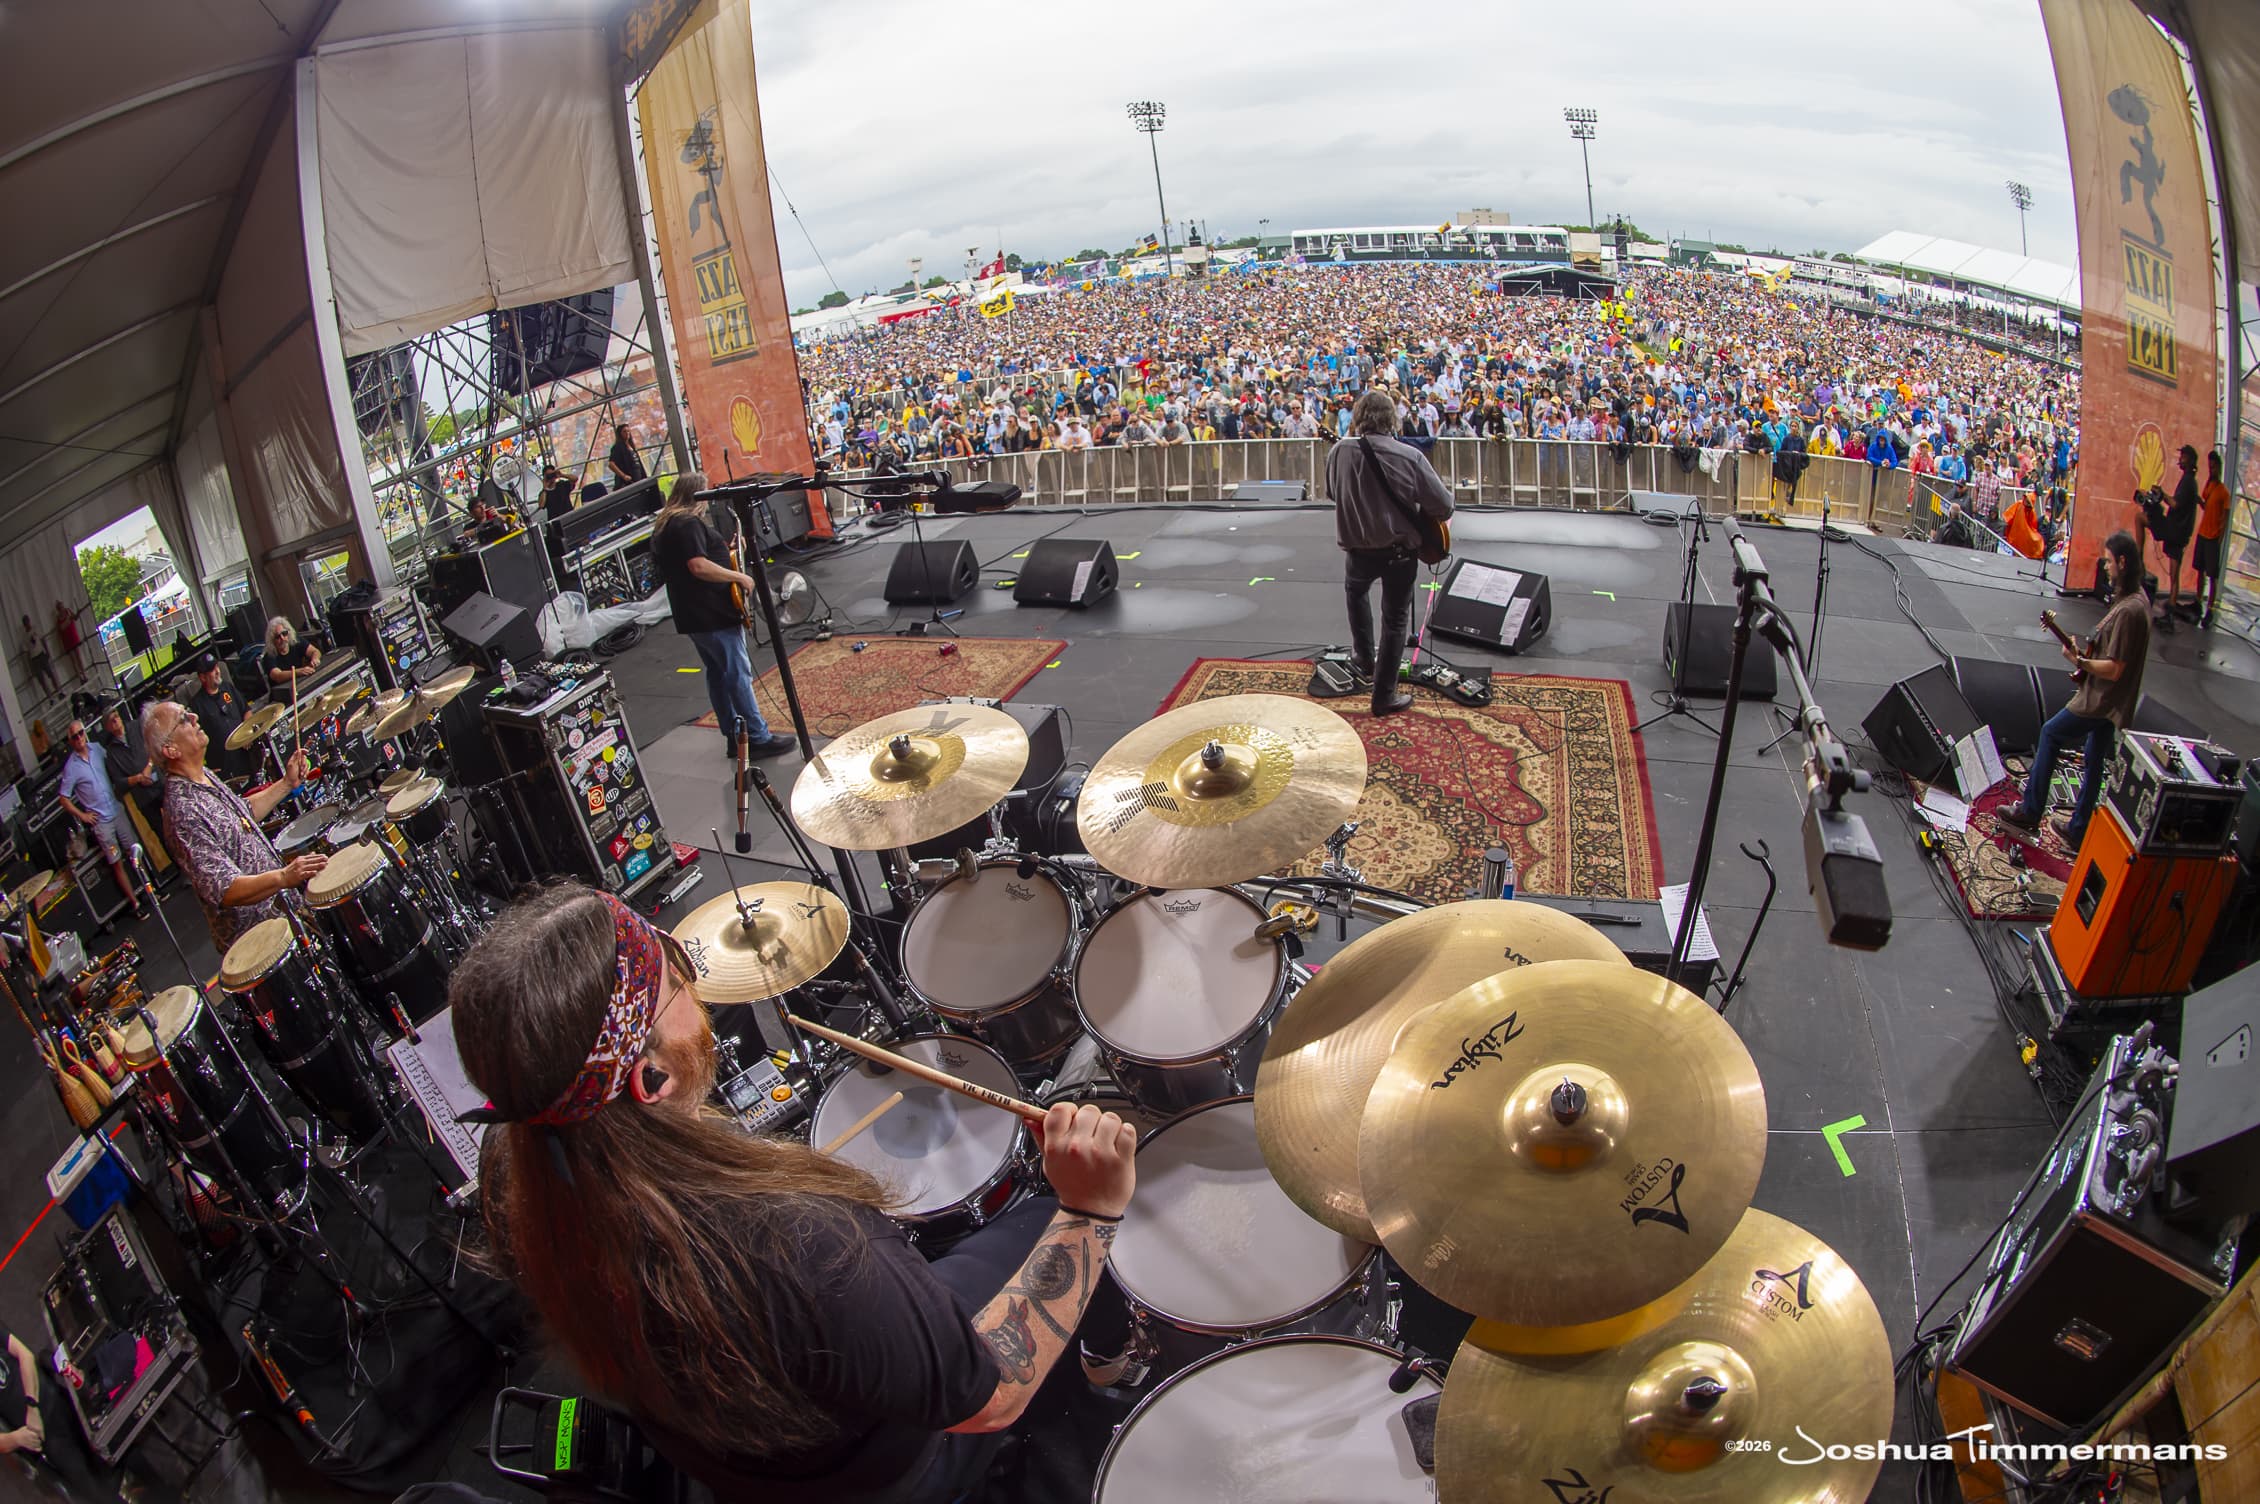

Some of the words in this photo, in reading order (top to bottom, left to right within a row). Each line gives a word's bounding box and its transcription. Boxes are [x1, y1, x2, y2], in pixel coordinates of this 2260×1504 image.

[614, 747, 626, 764] RAD
[683, 936, 710, 979] Zildjian
[1431, 1010, 1525, 1090] Zildjian
[962, 1081, 977, 1095] VIC
[981, 1089, 1012, 1106] FIRTH
[1620, 1158, 1674, 1214] CUSTOM
[1632, 1163, 1689, 1234] A
[1751, 1280, 1804, 1322] CUSTOM
[1755, 1260, 1814, 1309] A
